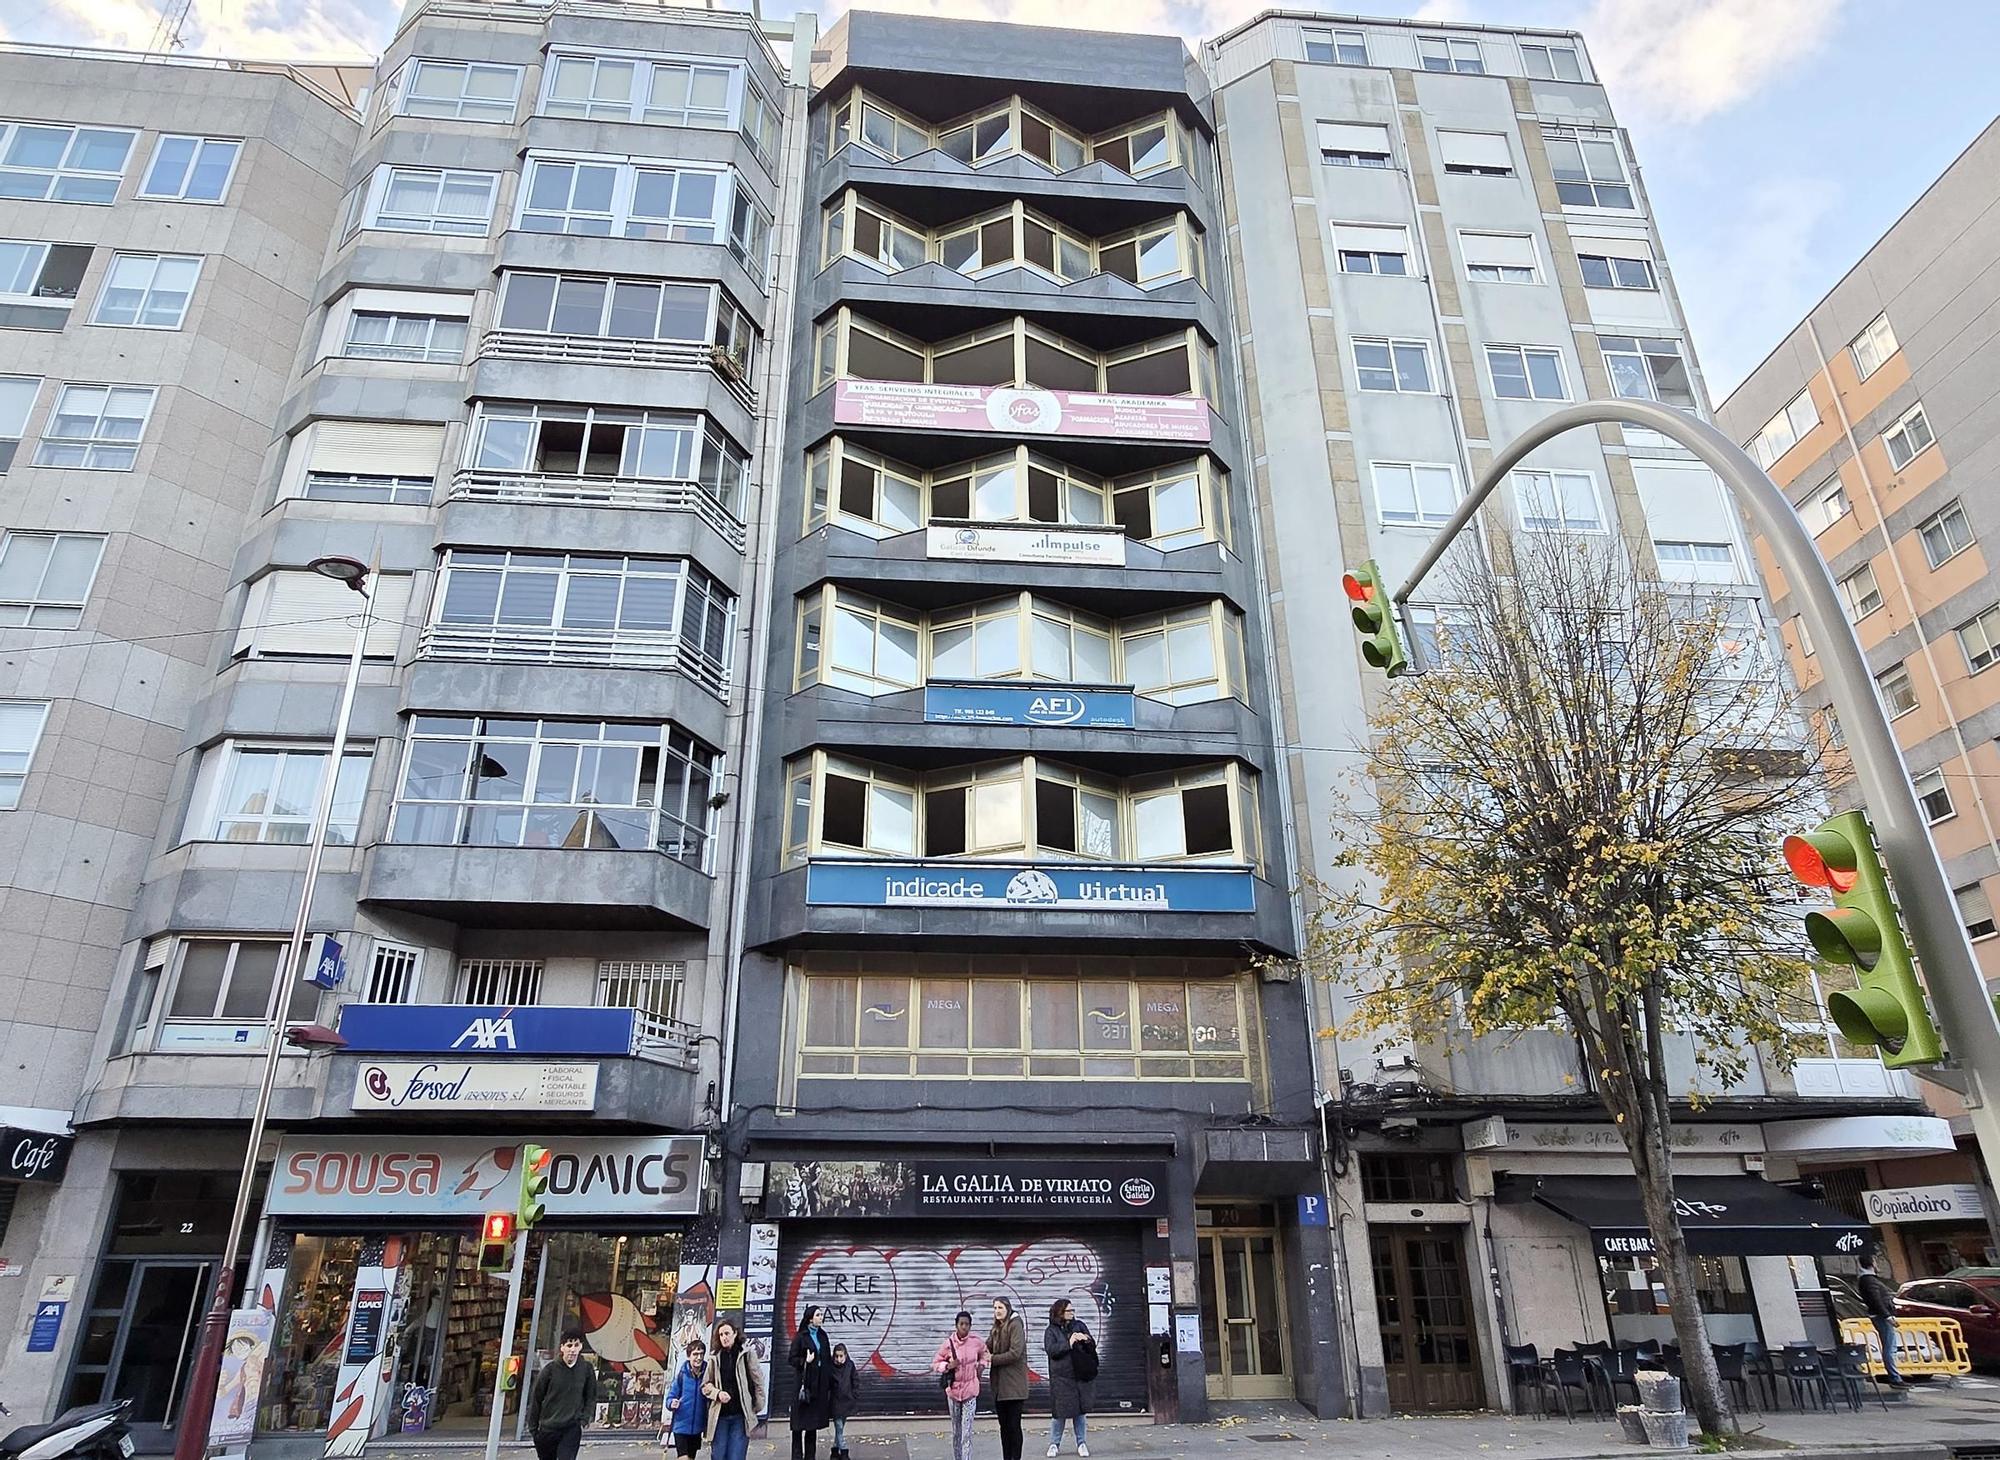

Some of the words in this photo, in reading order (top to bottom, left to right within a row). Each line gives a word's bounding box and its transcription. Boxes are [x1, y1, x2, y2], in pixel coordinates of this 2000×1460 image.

[879, 386, 922, 395] SERVICIOS
[923, 388, 976, 398] INTEGRALES
[1009, 403, 1040, 417] yfas
[1029, 697, 1072, 711] AFI
[886, 876, 984, 898] indicad-e
[318, 956, 336, 978] AXA
[927, 1000, 961, 1009] MEGA
[1146, 1002, 1180, 1013] MEGA
[450, 1017, 517, 1049] AXA
[546, 1074, 575, 1082] FISCAL
[391, 1064, 472, 1107] fersal
[546, 1082, 588, 1090] CONTABLE
[11, 1137, 59, 1178] Café
[537, 1153, 690, 1195] OMICS
[922, 1174, 949, 1193] LA
[953, 1174, 1015, 1193] GALIA
[1020, 1179, 1043, 1193] DE
[1045, 1178, 1112, 1193] VIRIATO
[1124, 1184, 1151, 1193] Estrella
[923, 1195, 994, 1204] RESTAURANTE
[1001, 1193, 1044, 1204] TAPERÍA
[1050, 1193, 1113, 1204] CERVECERÍA
[1125, 1191, 1150, 1200] Galicia
[1304, 1196, 1318, 1214] P
[180, 1222, 194, 1233] 22
[1604, 1237, 1630, 1252] CAFE
[1629, 1237, 1650, 1252] BAR
[1835, 1231, 1864, 1252] 18/70
[816, 1272, 881, 1294] FREE
